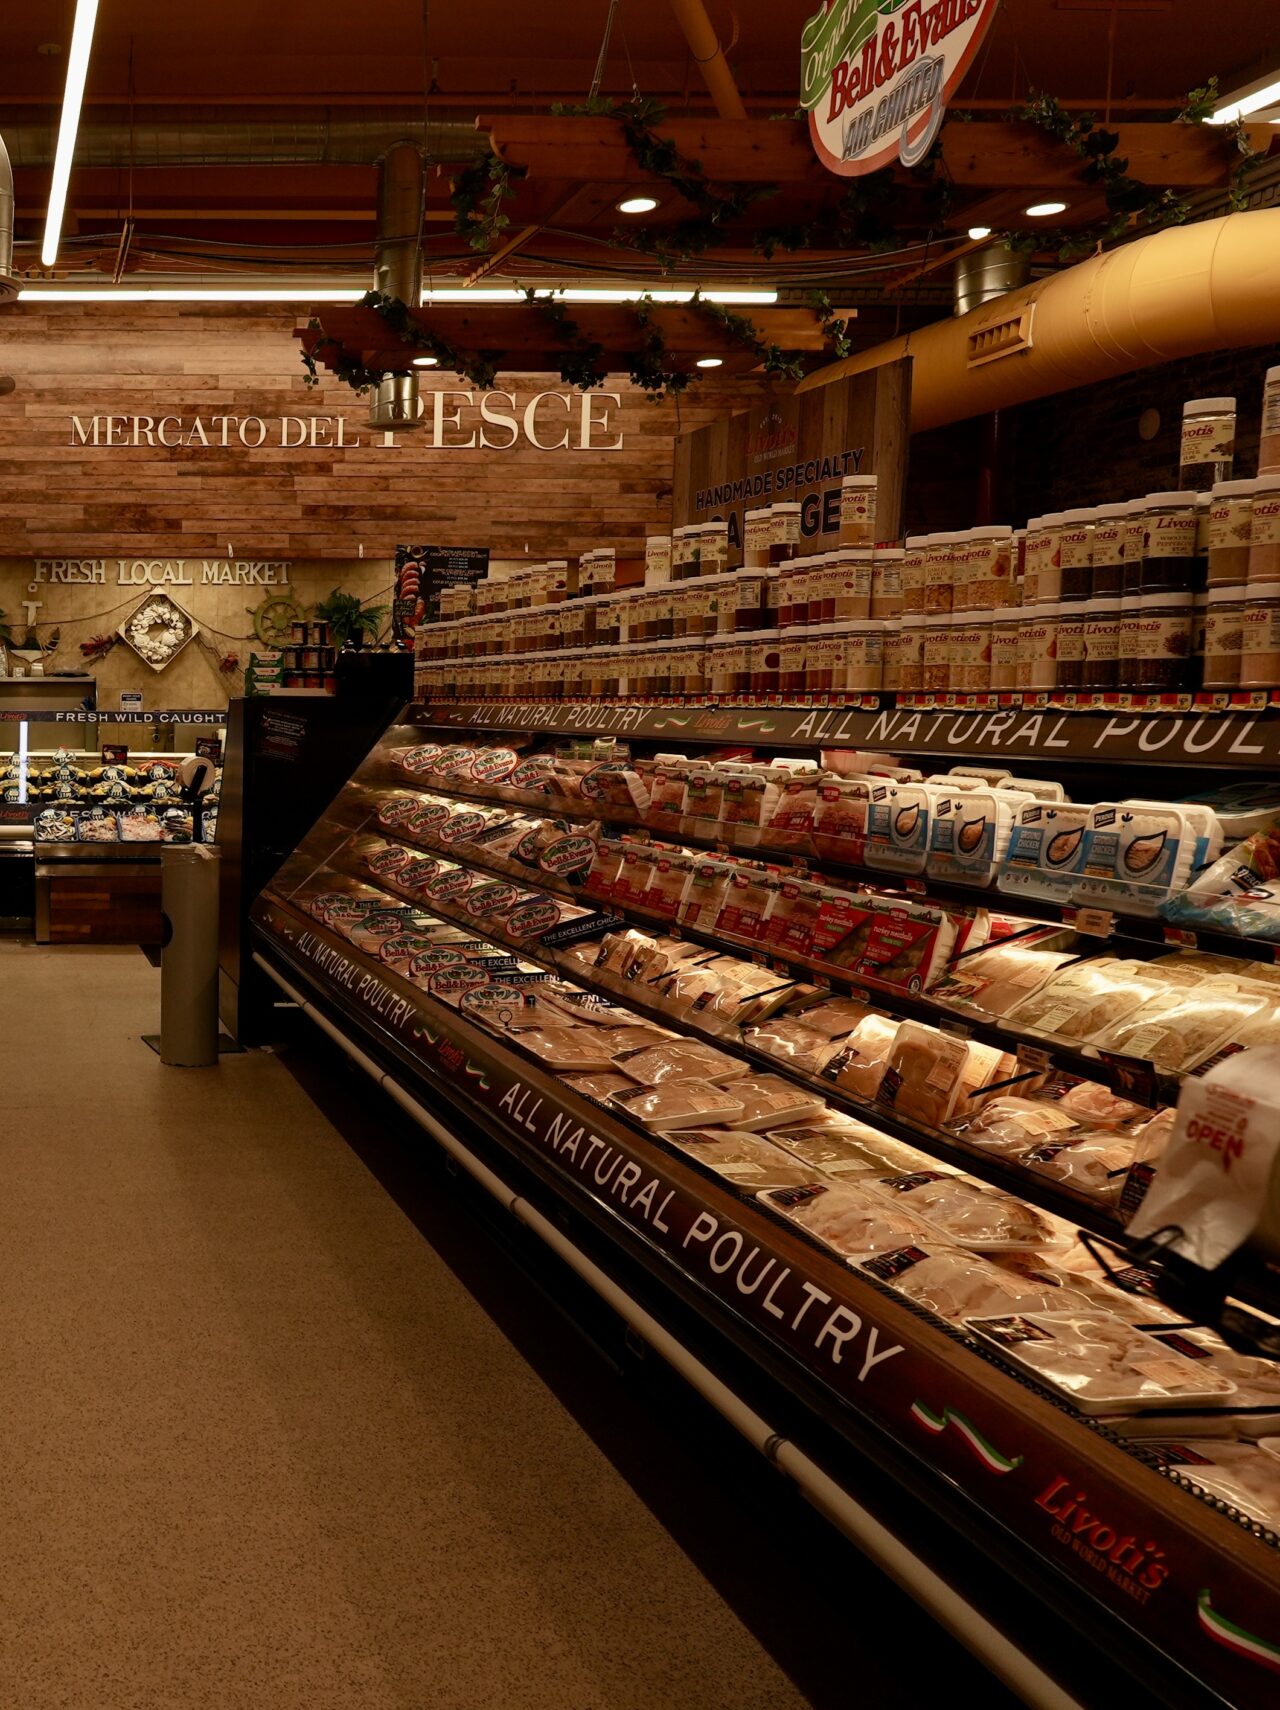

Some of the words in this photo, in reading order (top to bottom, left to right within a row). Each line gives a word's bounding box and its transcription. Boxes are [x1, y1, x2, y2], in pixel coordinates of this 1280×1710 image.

[805, 0, 863, 92] Organ
[69, 415, 267, 448] MERCATO
[278, 416, 360, 448] DEL
[696, 472, 772, 511] HANDMADE
[776, 447, 864, 491] SPECIALTY
[33, 559, 106, 585] FRESH
[117, 560, 193, 586] LOCAL
[201, 560, 293, 585] MARKET
[56, 713, 108, 722] FRESH
[115, 713, 153, 722] WILD
[160, 714, 225, 723] CAUGHT
[468, 706, 496, 724] ALL
[494, 706, 564, 727] NATURAL
[562, 706, 652, 731] POULTRY
[792, 711, 863, 740] ALL
[866, 711, 1071, 748] NATURAL
[546, 847, 594, 868] Bell&Evans
[542, 934, 557, 943] THE
[557, 921, 596, 938] EXCELLENT
[296, 931, 312, 957] ALL
[312, 942, 355, 989] NATURAL
[355, 974, 416, 1029] POULTRY
[493, 976, 510, 985] THE
[1186, 1120, 1246, 1159] OPEN
[498, 1082, 548, 1134] ALL
[543, 1112, 679, 1235] NATURAL
[682, 1210, 906, 1384] POULTRY
[1050, 1523, 1071, 1547] OLD
[1070, 1537, 1107, 1574] WORLD
[1106, 1564, 1152, 1606] MARKET
